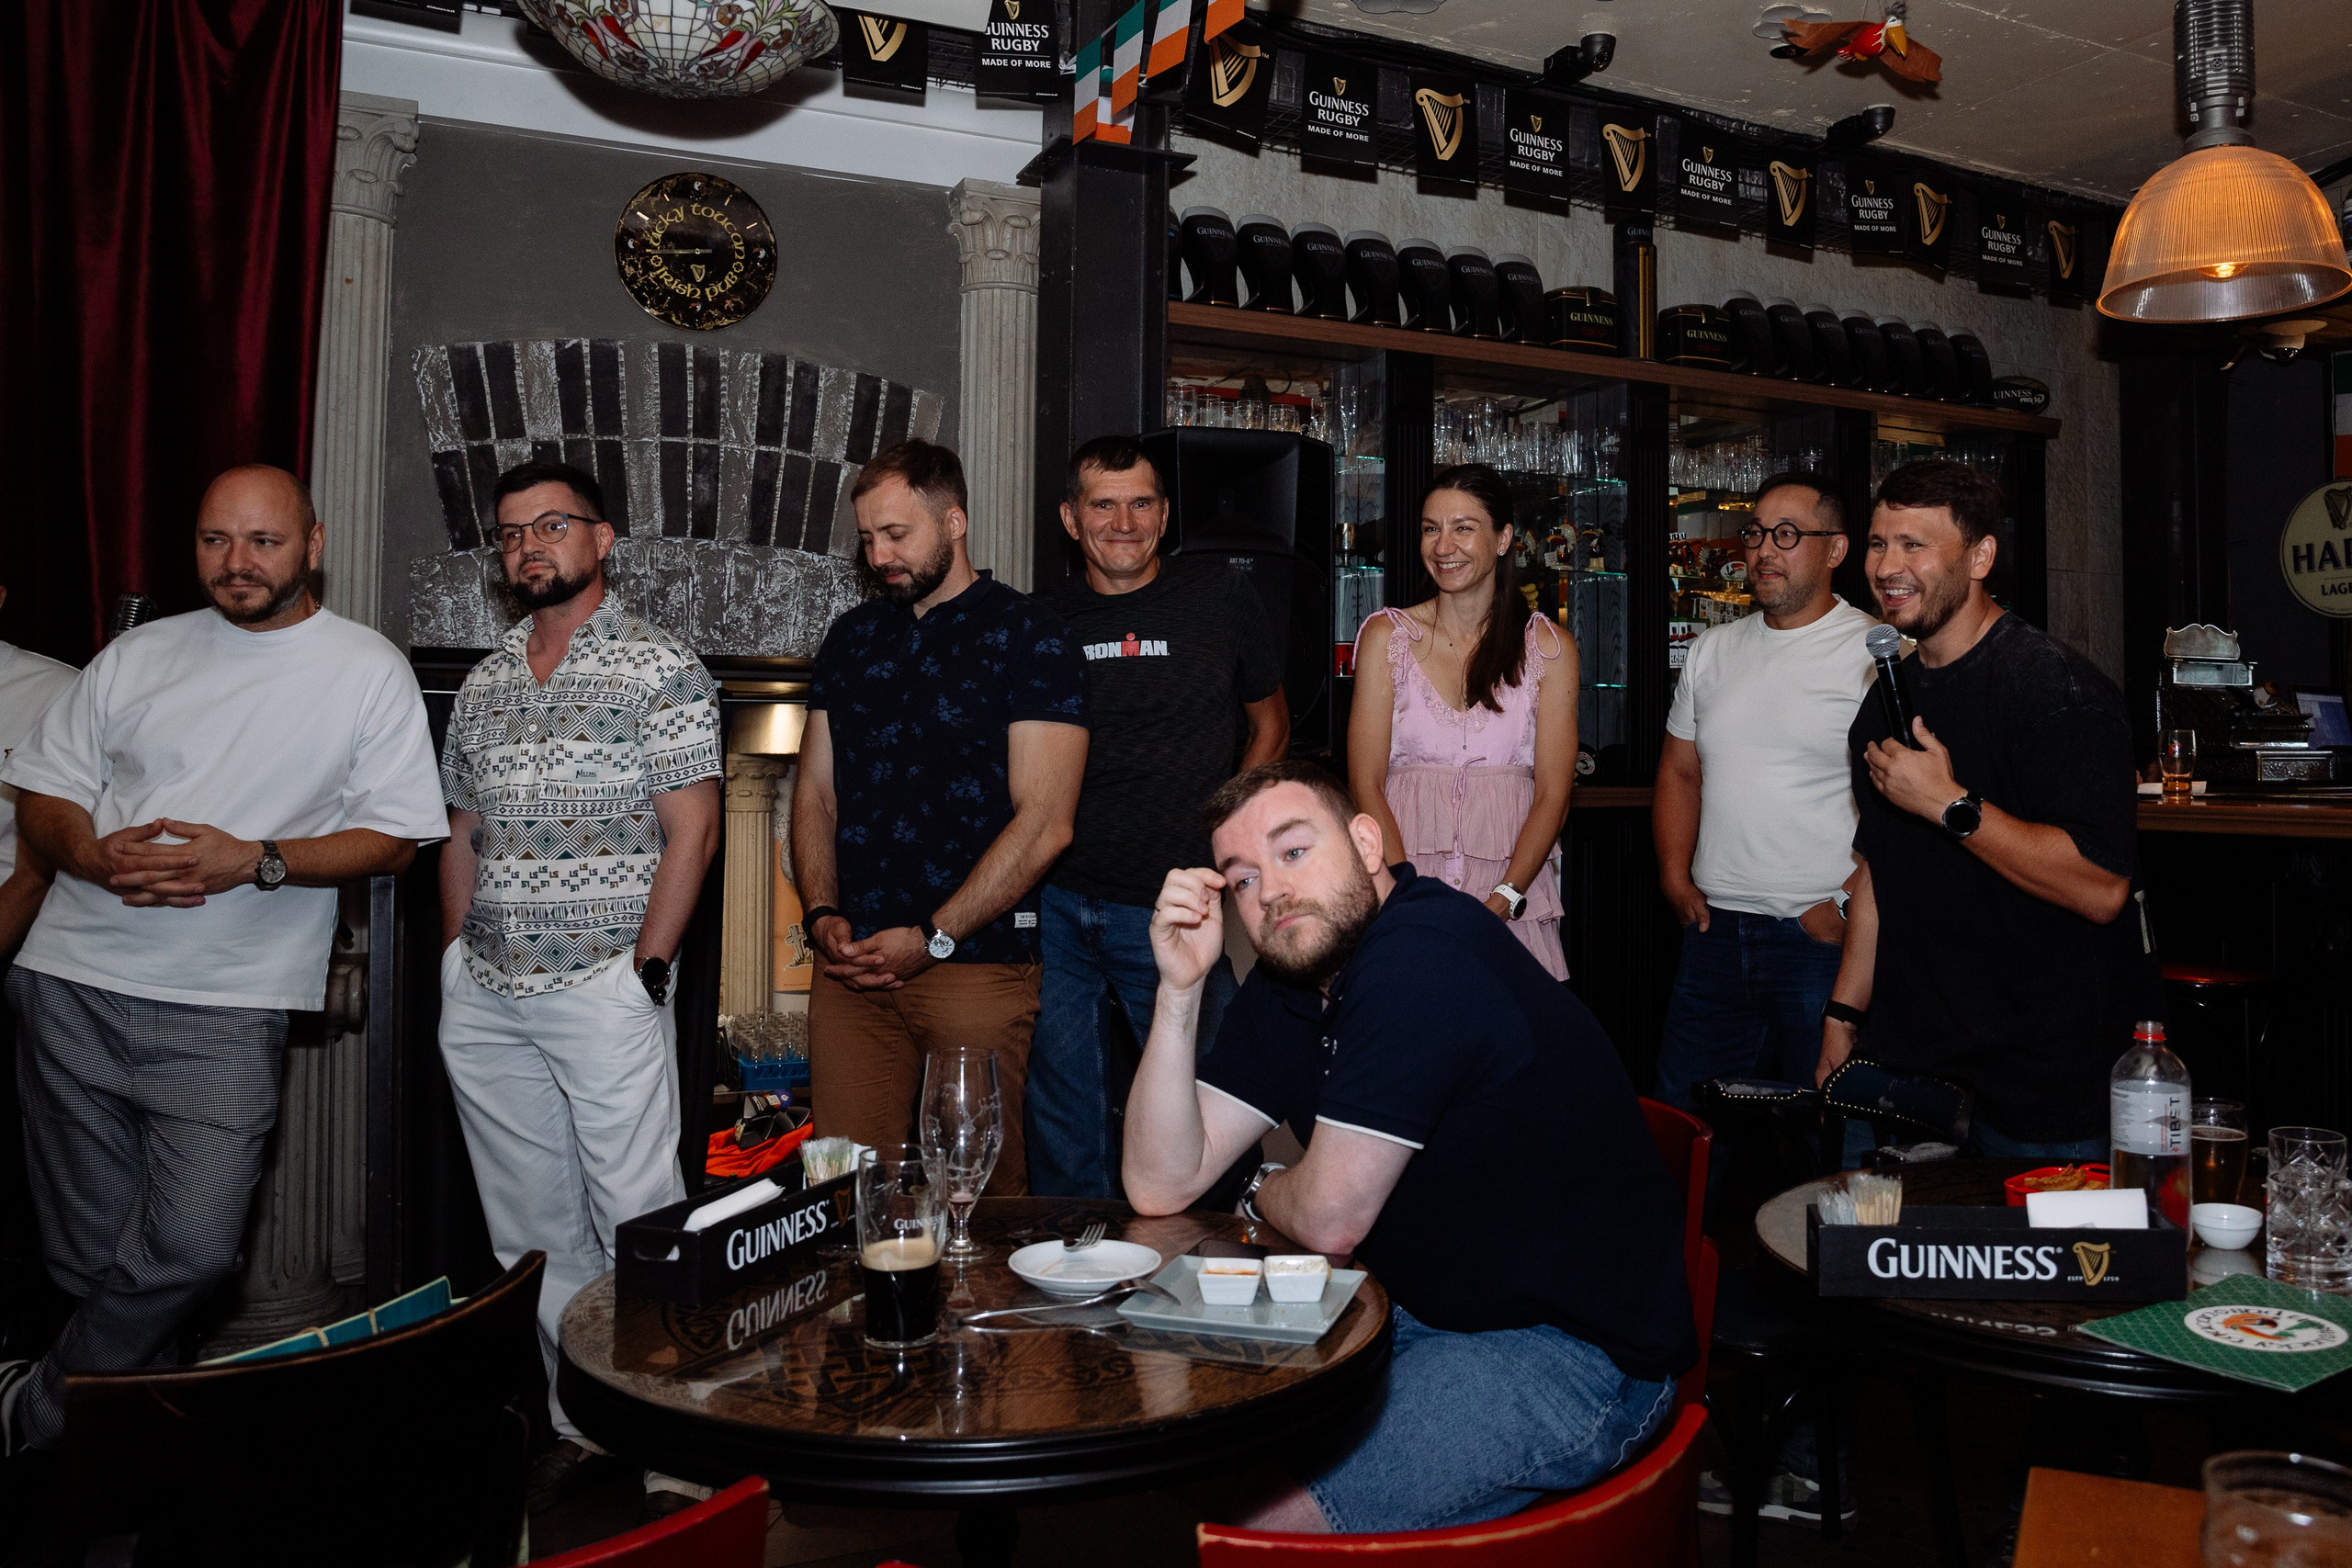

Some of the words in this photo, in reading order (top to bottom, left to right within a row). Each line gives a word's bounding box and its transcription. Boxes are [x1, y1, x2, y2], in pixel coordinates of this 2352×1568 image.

[990, 38, 1040, 51] RUGBY
[981, 58, 1009, 66] MADE
[1025, 60, 1051, 68] MORE
[1308, 90, 1369, 117] GUINNESS
[1317, 108, 1361, 127] RUGBY
[1307, 125, 1331, 136] MADE
[1345, 132, 1369, 142] MORE
[1509, 128, 1563, 152] GUINNESS
[1518, 145, 1555, 163] RUGBY
[1509, 159, 1531, 171] MADE
[1531, 164, 1542, 173] OF
[1543, 166, 1563, 177] MORE
[1681, 158, 1733, 183] GUINNESS
[1689, 174, 1725, 192] RUGBY
[1680, 187, 1701, 198] MADE
[1701, 193, 1712, 201] OF
[1712, 195, 1733, 206] MORE
[1850, 194, 1894, 209] GUINNESS
[1859, 209, 1889, 220] RUGBY
[1626, 226, 1651, 237] GUINN
[1871, 224, 1880, 232] OF
[1880, 225, 1897, 233] MORE
[1981, 226, 2021, 246] GUINNESS
[1987, 241, 2017, 255] RUGBY
[1982, 254, 1997, 263] MADE
[2007, 258, 2023, 266] MORE
[1569, 312, 1613, 326] GUINNESS
[1686, 329, 1727, 344] GUINNESS
[1994, 389, 2032, 400] UINNESS
[2291, 538, 2352, 574] HA
[2321, 581, 2352, 596] LAGE
[1082, 632, 1168, 661] RONMAN
[2170, 1097, 2181, 1147] TIBET
[726, 1202, 828, 1271] GUINNESS
[1867, 1237, 2058, 1280] GUINNESS
